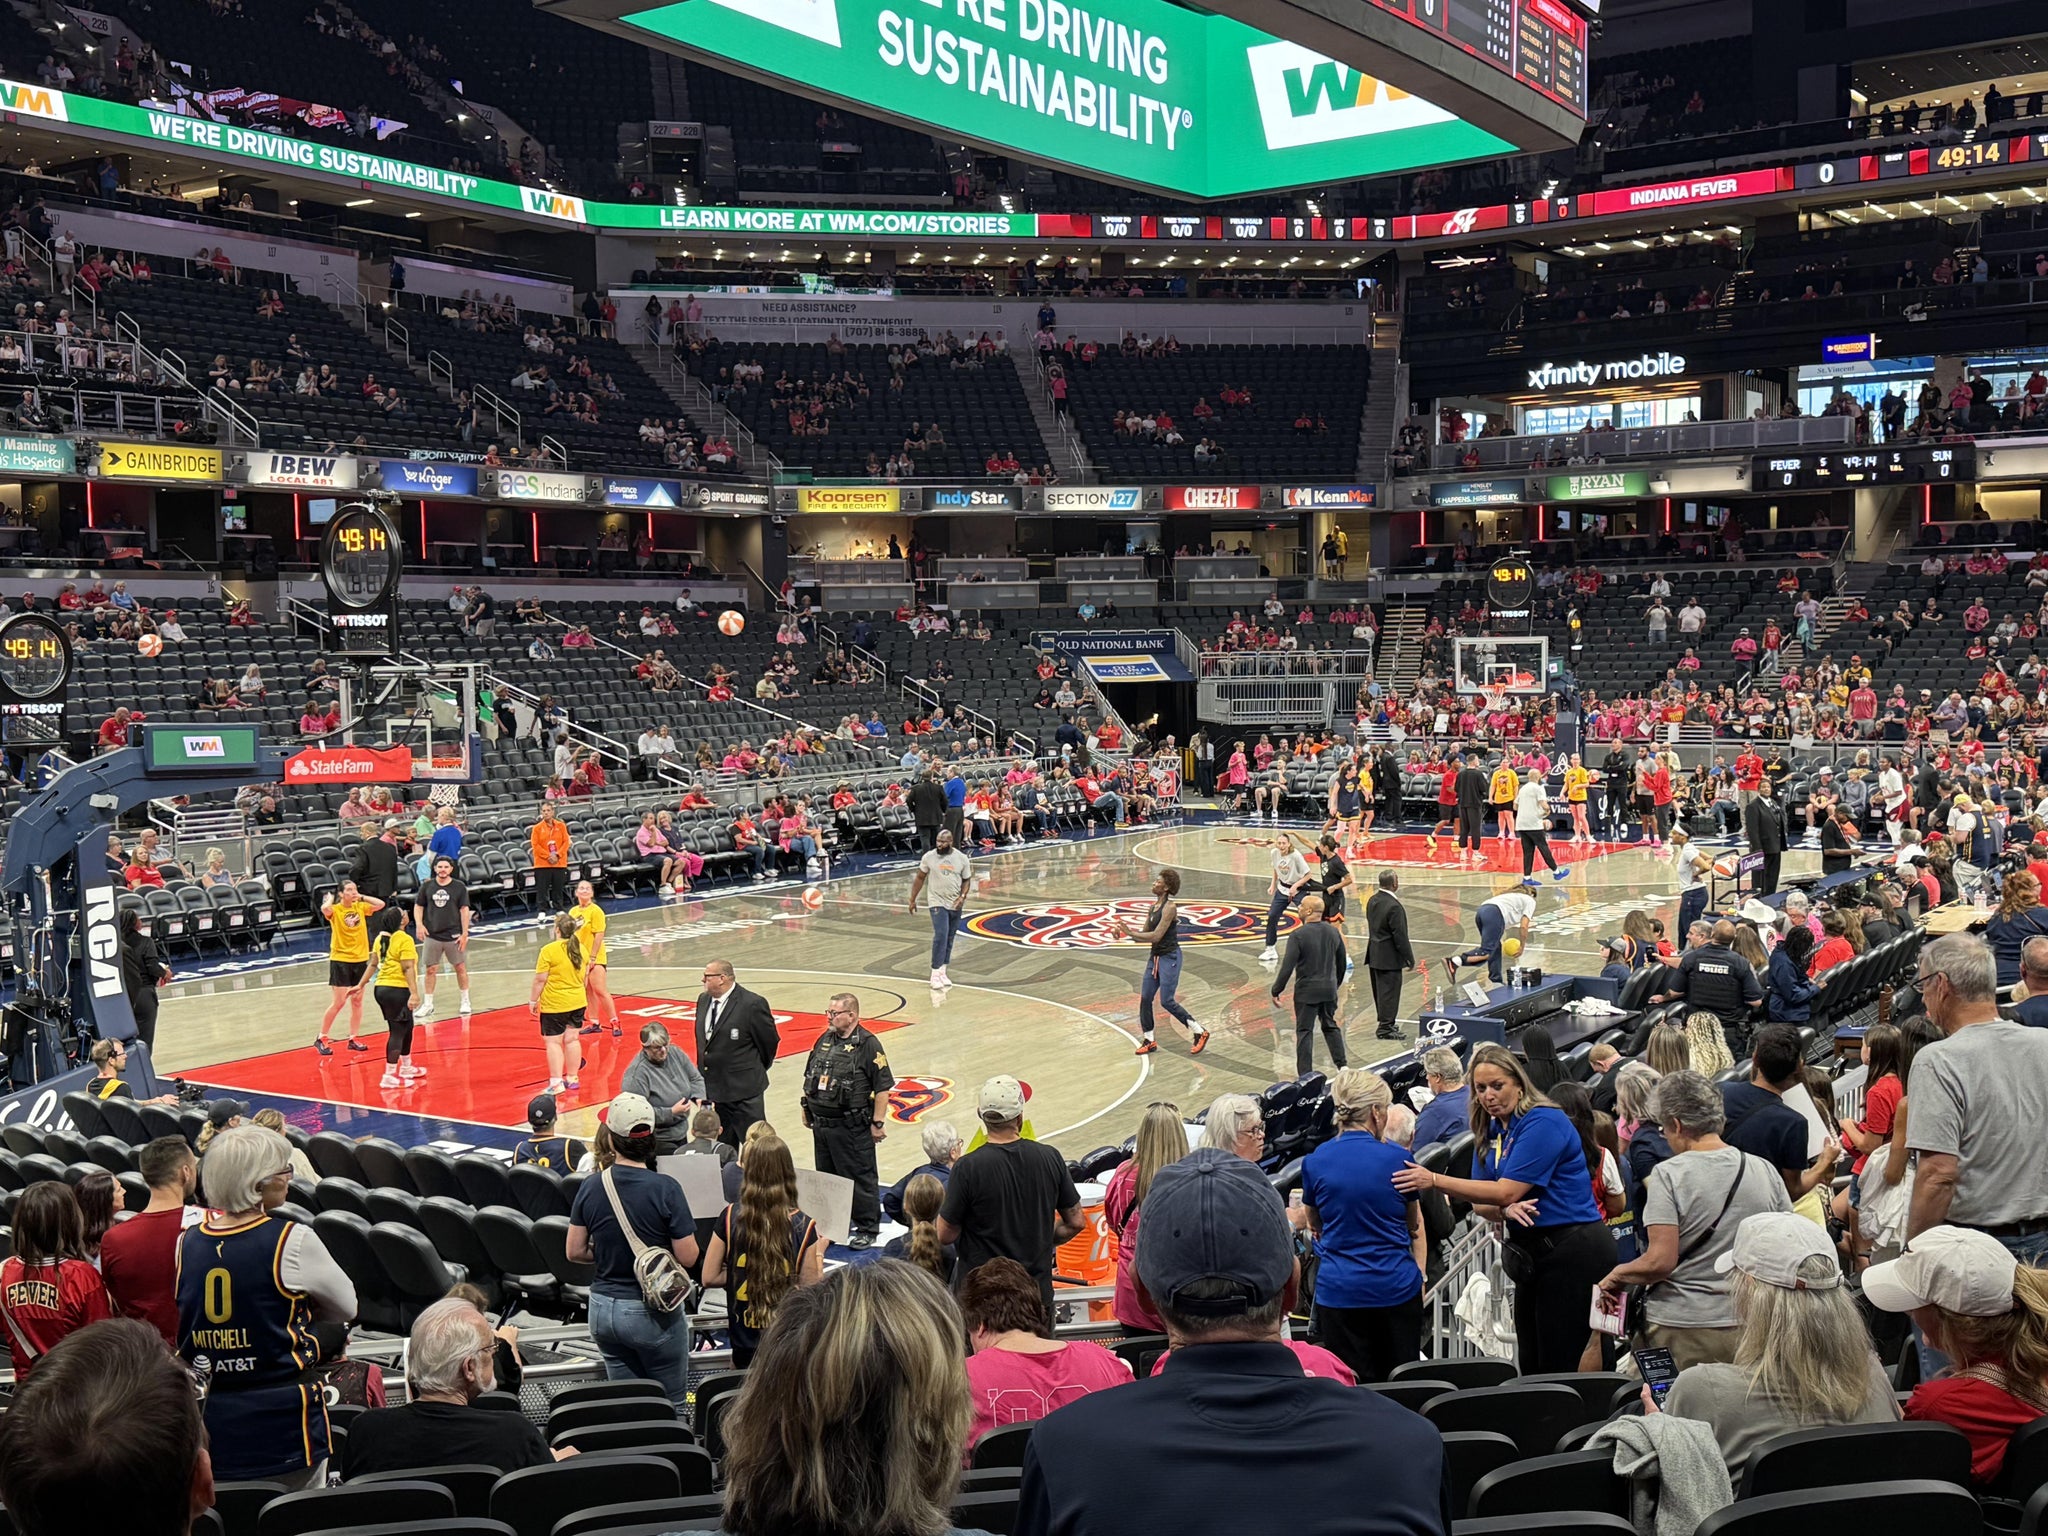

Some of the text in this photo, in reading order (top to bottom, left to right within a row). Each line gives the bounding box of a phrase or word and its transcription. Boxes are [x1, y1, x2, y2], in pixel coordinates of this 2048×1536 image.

[91, 17, 109, 31] 226
[1019, 0, 1168, 84] DRIVING
[226, 128, 314, 165] DRIVING
[1937, 143, 2000, 168] 49:14
[1819, 163, 1834, 183] 0
[1629, 178, 1737, 206] INDIANA FEVER
[530, 191, 577, 219] WM
[1558, 205, 1568, 218] 0
[659, 209, 1011, 235] LEARN MORE AT WM.COM/STORIES
[1516, 210, 1525, 224] 5
[1105, 223, 1127, 236] 0/0
[1170, 224, 1192, 237] 0/0
[1235, 225, 1257, 238] 0/0
[1294, 226, 1303, 238] 0
[1335, 226, 1344, 239] 0
[1375, 226, 1384, 239] 0
[762, 303, 856, 313] NEED ASSISTANCE?
[1528, 352, 1686, 391] xfinity mobile
[5, 440, 57, 454] Manning
[13, 453, 65, 469] Hospital
[127, 451, 217, 473] GAINBRIDGE
[1843, 456, 1877, 468] 49:14
[1932, 451, 1952, 462] SUN
[270, 455, 336, 476] IBEW
[1770, 460, 1801, 471] FEVER
[1941, 465, 1949, 477] 0
[270, 475, 334, 486] LOCAL 481
[418, 466, 453, 491] Kroger
[1581, 474, 1624, 489] RYAN
[1783, 473, 1792, 485] 0
[501, 473, 584, 499] aes Indiana
[609, 485, 637, 494] Elevance
[711, 491, 734, 503] SPORT
[735, 493, 769, 505] GRAPHICS
[808, 490, 888, 502] Koorsen
[1047, 492, 1132, 506] SECTION 127
[1314, 490, 1374, 503] KennMar
[339, 528, 385, 551] 49:14
[1493, 568, 1526, 581] 49:14
[286, 582, 293, 593] 17
[1502, 610, 1529, 618] TISSOT
[348, 615, 388, 627] TISSOT
[5, 639, 56, 658] 49:14
[1058, 640, 1164, 649] OLD NATIONAL BANK
[20, 704, 64, 714] TISSOT
[190, 740, 218, 751] WM
[1699, 965, 1729, 974] POLICE
[5, 1280, 60, 1312] FEVER
[204, 1267, 232, 1325] 0
[192, 1328, 251, 1351] MITCHELL
[215, 1357, 257, 1373] AT&T
